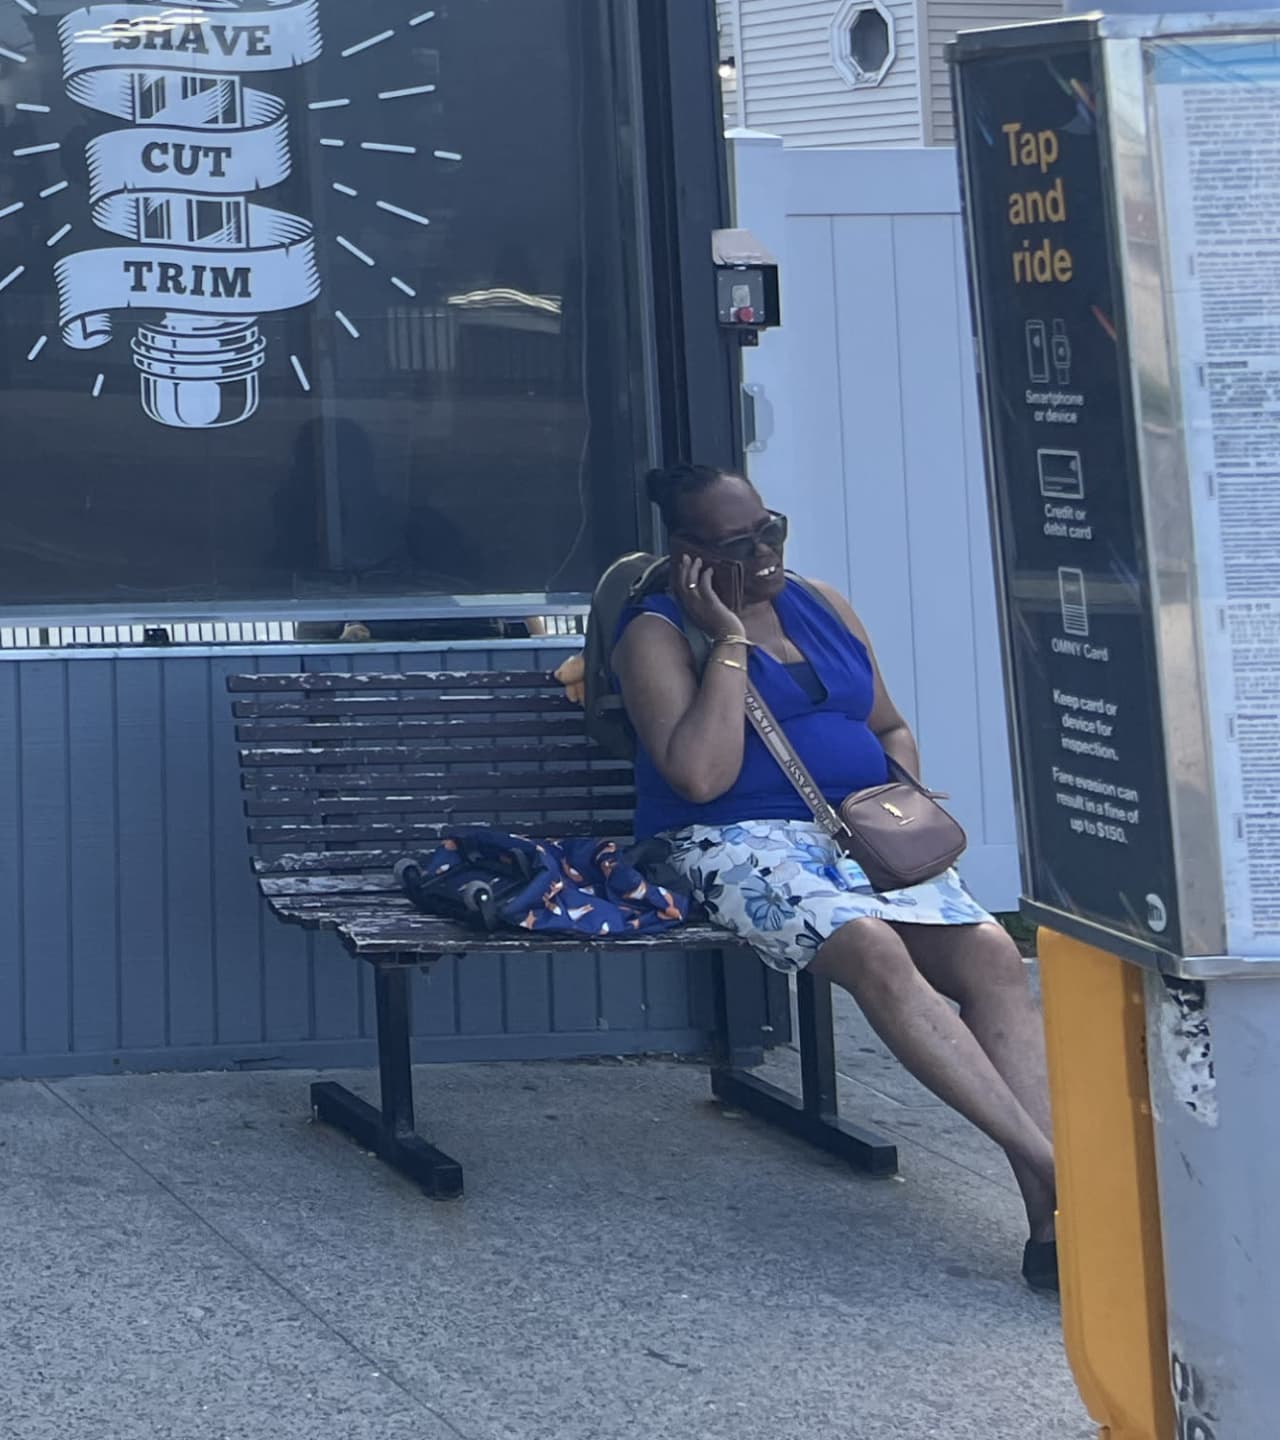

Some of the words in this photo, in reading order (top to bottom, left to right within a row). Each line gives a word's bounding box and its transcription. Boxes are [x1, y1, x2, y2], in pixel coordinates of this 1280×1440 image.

[112, 18, 272, 57] SHAVE
[141, 141, 232, 178] CUT
[1002, 123, 1058, 174] Tap
[1008, 177, 1066, 225] and
[1012, 238, 1073, 283] ride
[123, 260, 252, 298] TRIM
[1025, 389, 1084, 407] Smartphone
[1034, 411, 1044, 421] or
[1046, 409, 1077, 423] device
[1044, 504, 1074, 520] Credit
[1075, 511, 1086, 520] or
[1043, 522, 1067, 537] debit
[1069, 525, 1092, 540] card
[1051, 638, 1081, 657] OMNY
[1083, 644, 1108, 661] Card
[1053, 688, 1079, 710] Keep
[1080, 696, 1104, 715] card
[1105, 704, 1118, 716] or
[1062, 713, 1096, 734] device
[1096, 720, 1113, 736] for
[1052, 766, 1074, 786] Fare
[1075, 774, 1115, 797] evasion
[1117, 786, 1139, 802] can
[1056, 792, 1085, 810] result
[1104, 802, 1126, 821] fine
[1127, 808, 1139, 824] of
[1070, 818, 1083, 834] up
[1084, 820, 1096, 835] to
